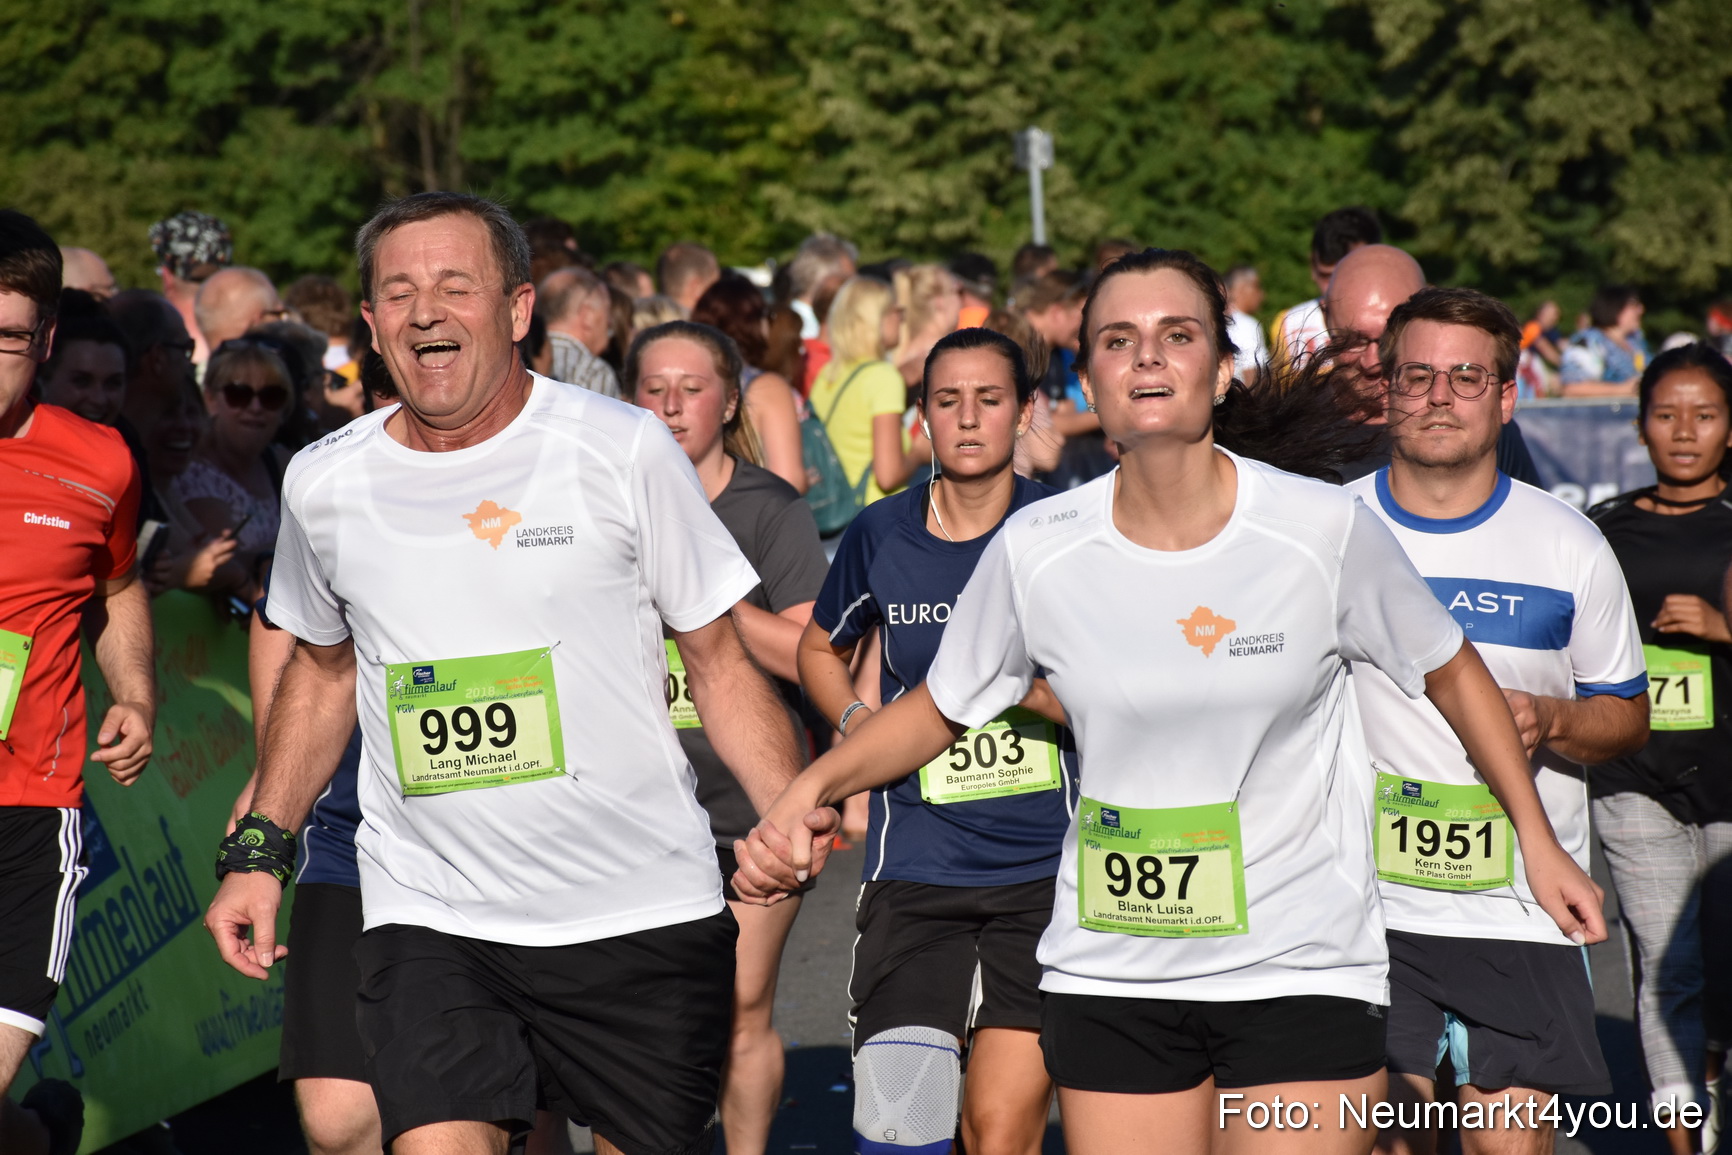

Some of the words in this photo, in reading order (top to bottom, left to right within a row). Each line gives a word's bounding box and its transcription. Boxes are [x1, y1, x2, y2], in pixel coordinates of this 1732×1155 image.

[24, 512, 70, 529] Christian
[481, 517, 501, 529] NM
[1048, 510, 1078, 524] JAKO
[516, 526, 574, 538] LANDKREIS
[516, 536, 574, 548] NEUMARKT
[888, 594, 961, 625] EURO
[1443, 590, 1524, 616] AST
[1195, 624, 1215, 637] NM
[1229, 632, 1285, 647] LANDKREIS
[1229, 643, 1285, 657] NEUMARKT
[404, 679, 458, 695] firmenlauf
[465, 686, 496, 698] 2018
[1650, 676, 1690, 705] 71
[420, 702, 517, 755] 999
[948, 729, 1025, 772] 503
[430, 758, 462, 771] Lang
[466, 750, 517, 766] Michael
[412, 771, 462, 782] Landratsamt
[464, 765, 507, 778] Neumarkt
[509, 760, 543, 773] i.d.OPf.
[946, 771, 995, 784] Baumann
[997, 766, 1034, 778] Sophie
[961, 782, 997, 791] Europoles
[998, 778, 1020, 786] GmbH
[1393, 793, 1440, 808] firmenlauf
[1445, 808, 1472, 817] 2018
[1093, 821, 1142, 839] firmenlauf
[1150, 839, 1181, 849] 2018
[1391, 816, 1492, 860] 1951
[1415, 858, 1441, 870] Kern
[1444, 862, 1473, 871] Sven
[1105, 852, 1200, 900] 987
[1415, 869, 1425, 877] TR
[1426, 870, 1446, 879] Plast
[1448, 872, 1472, 880] GmbH
[63, 814, 199, 1010] irmenlauf
[1118, 900, 1154, 914] Blank
[1157, 904, 1194, 915] Luisa
[1093, 910, 1143, 923] Landratsamt
[1145, 916, 1188, 925] Neumarkt
[1190, 915, 1225, 925] i.d.OPf.
[84, 978, 150, 1058] neumarkt
